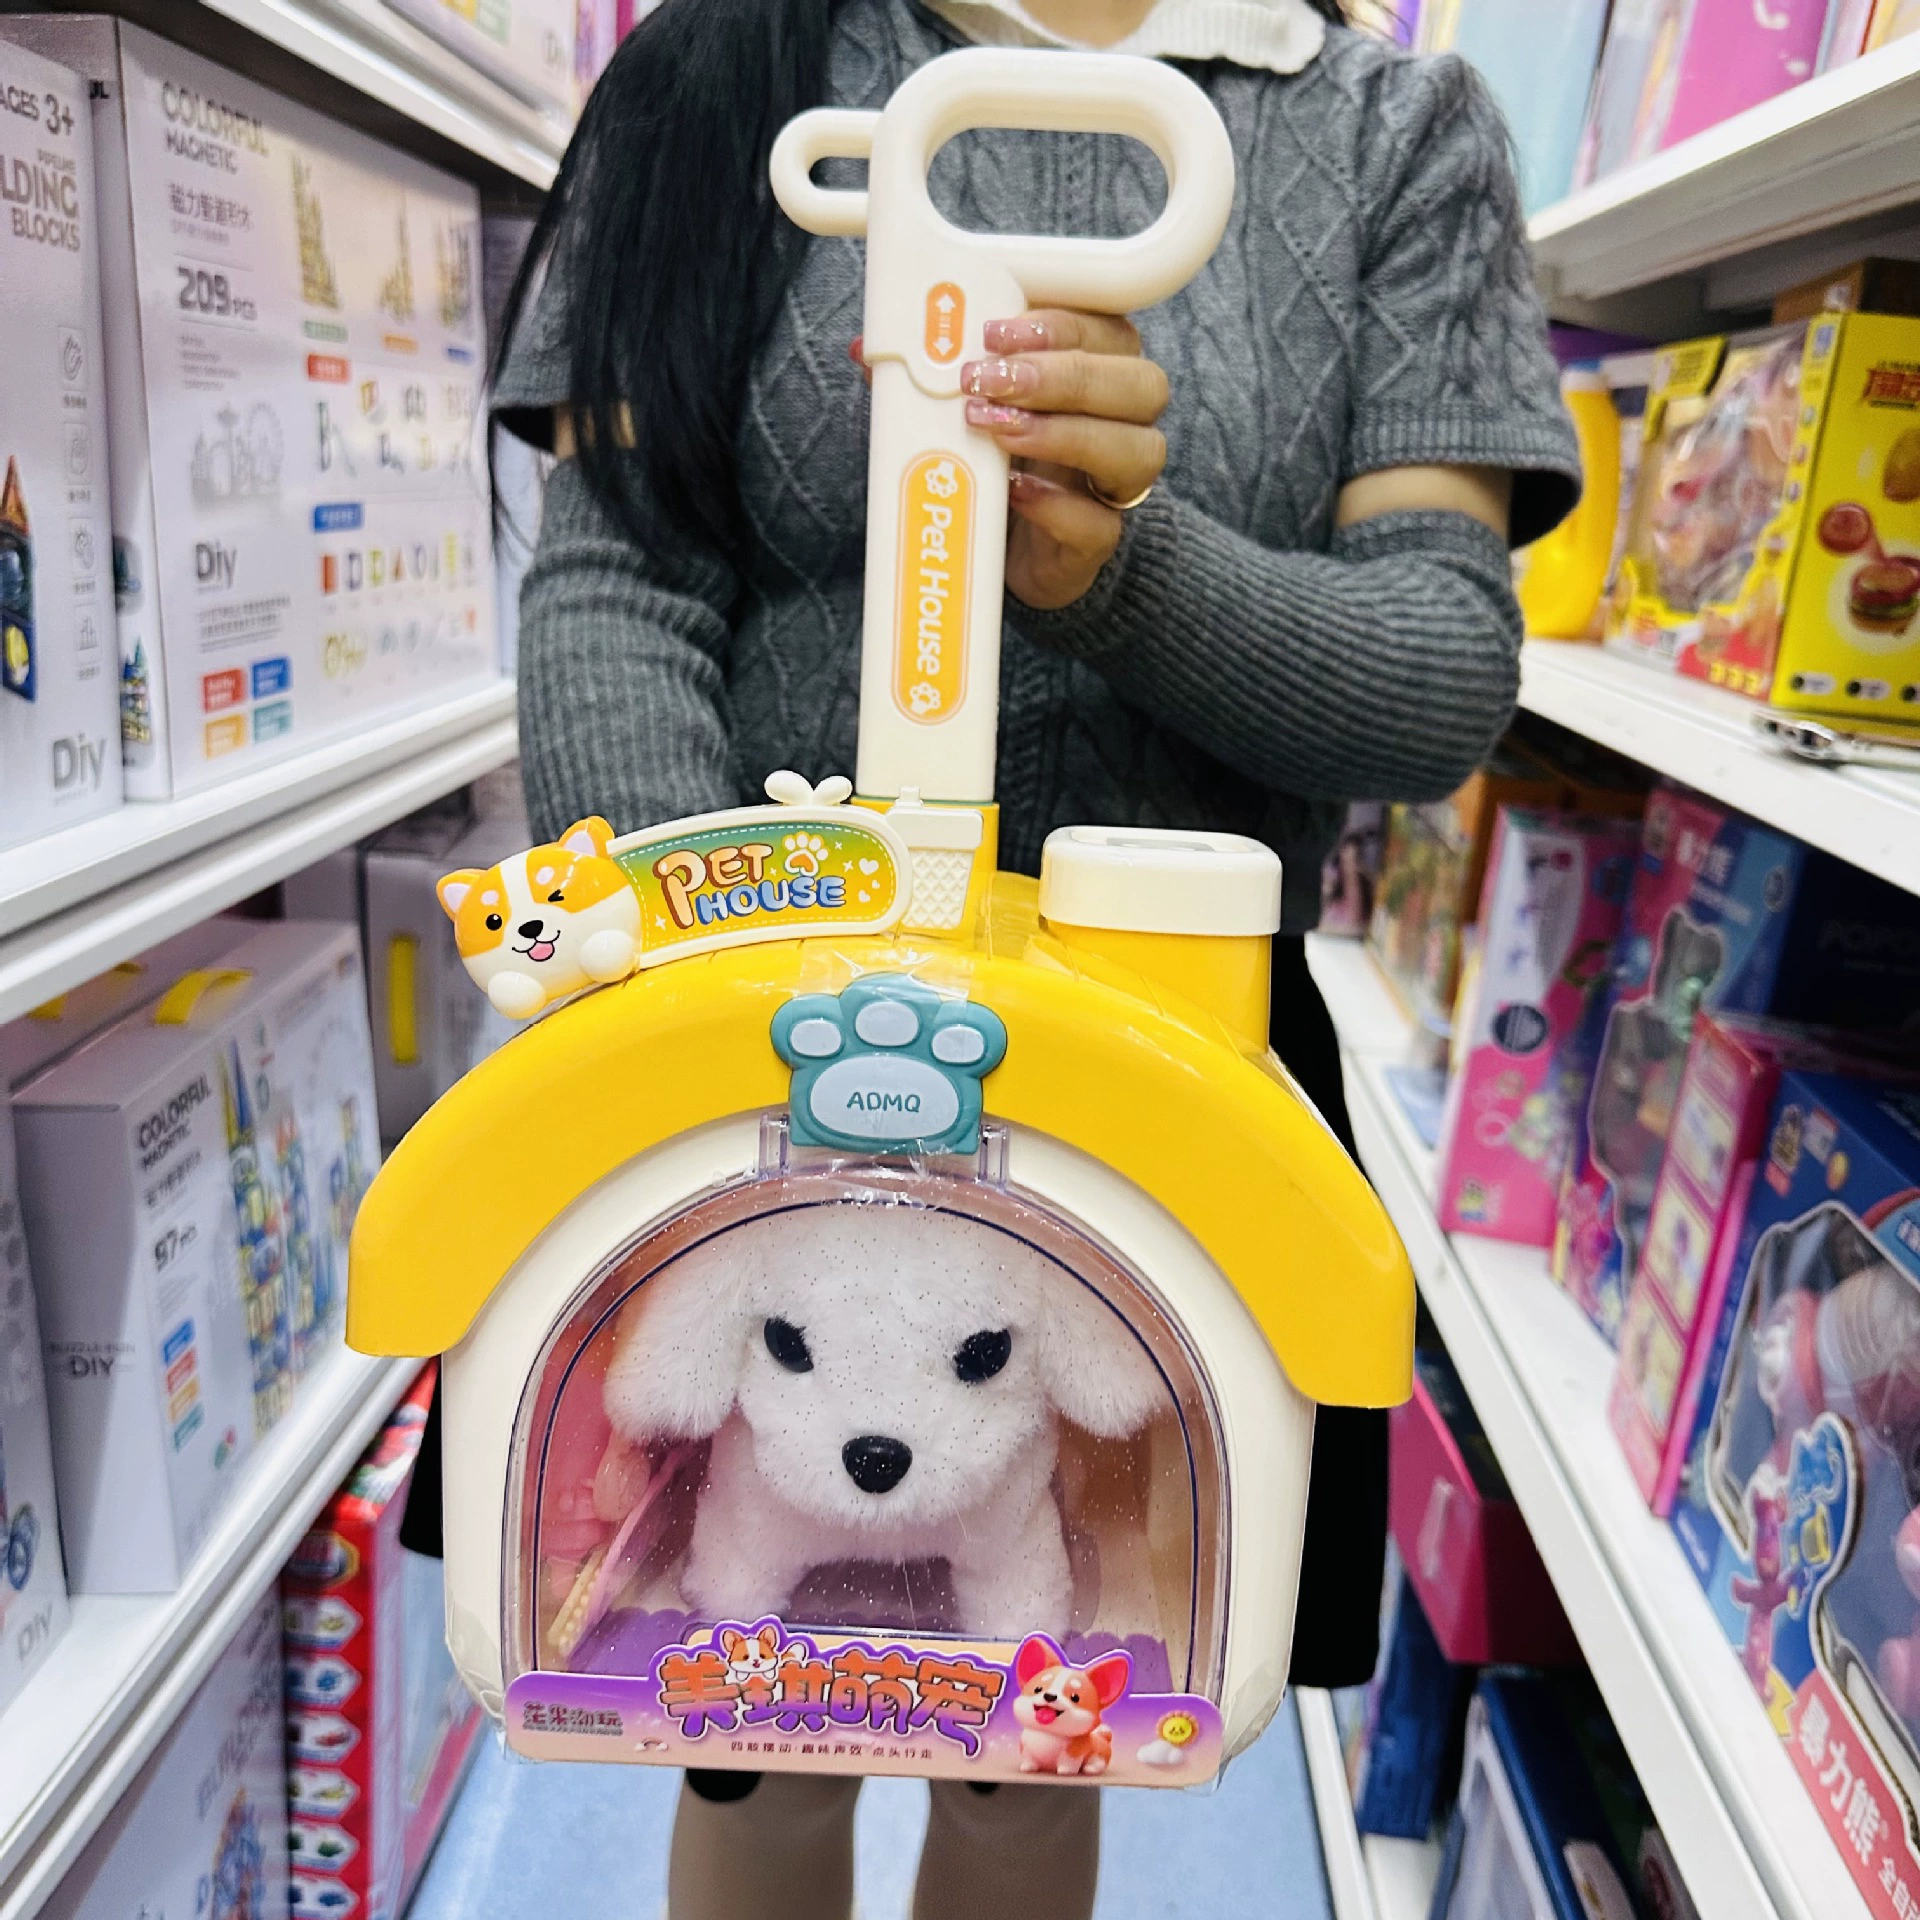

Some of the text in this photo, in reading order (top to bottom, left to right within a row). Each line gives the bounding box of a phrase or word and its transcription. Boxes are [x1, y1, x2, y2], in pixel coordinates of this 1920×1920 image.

[12, 205, 81, 253] BLOCKS
[195, 540, 238, 590] Diy
[915, 502, 953, 677] Pet House
[52, 732, 107, 793] Diy
[652, 842, 774, 930] PET
[695, 875, 847, 926] HOUSE
[846, 1091, 921, 1113] ADMQ
[659, 1648, 1005, 1757] 美琪萌宠
